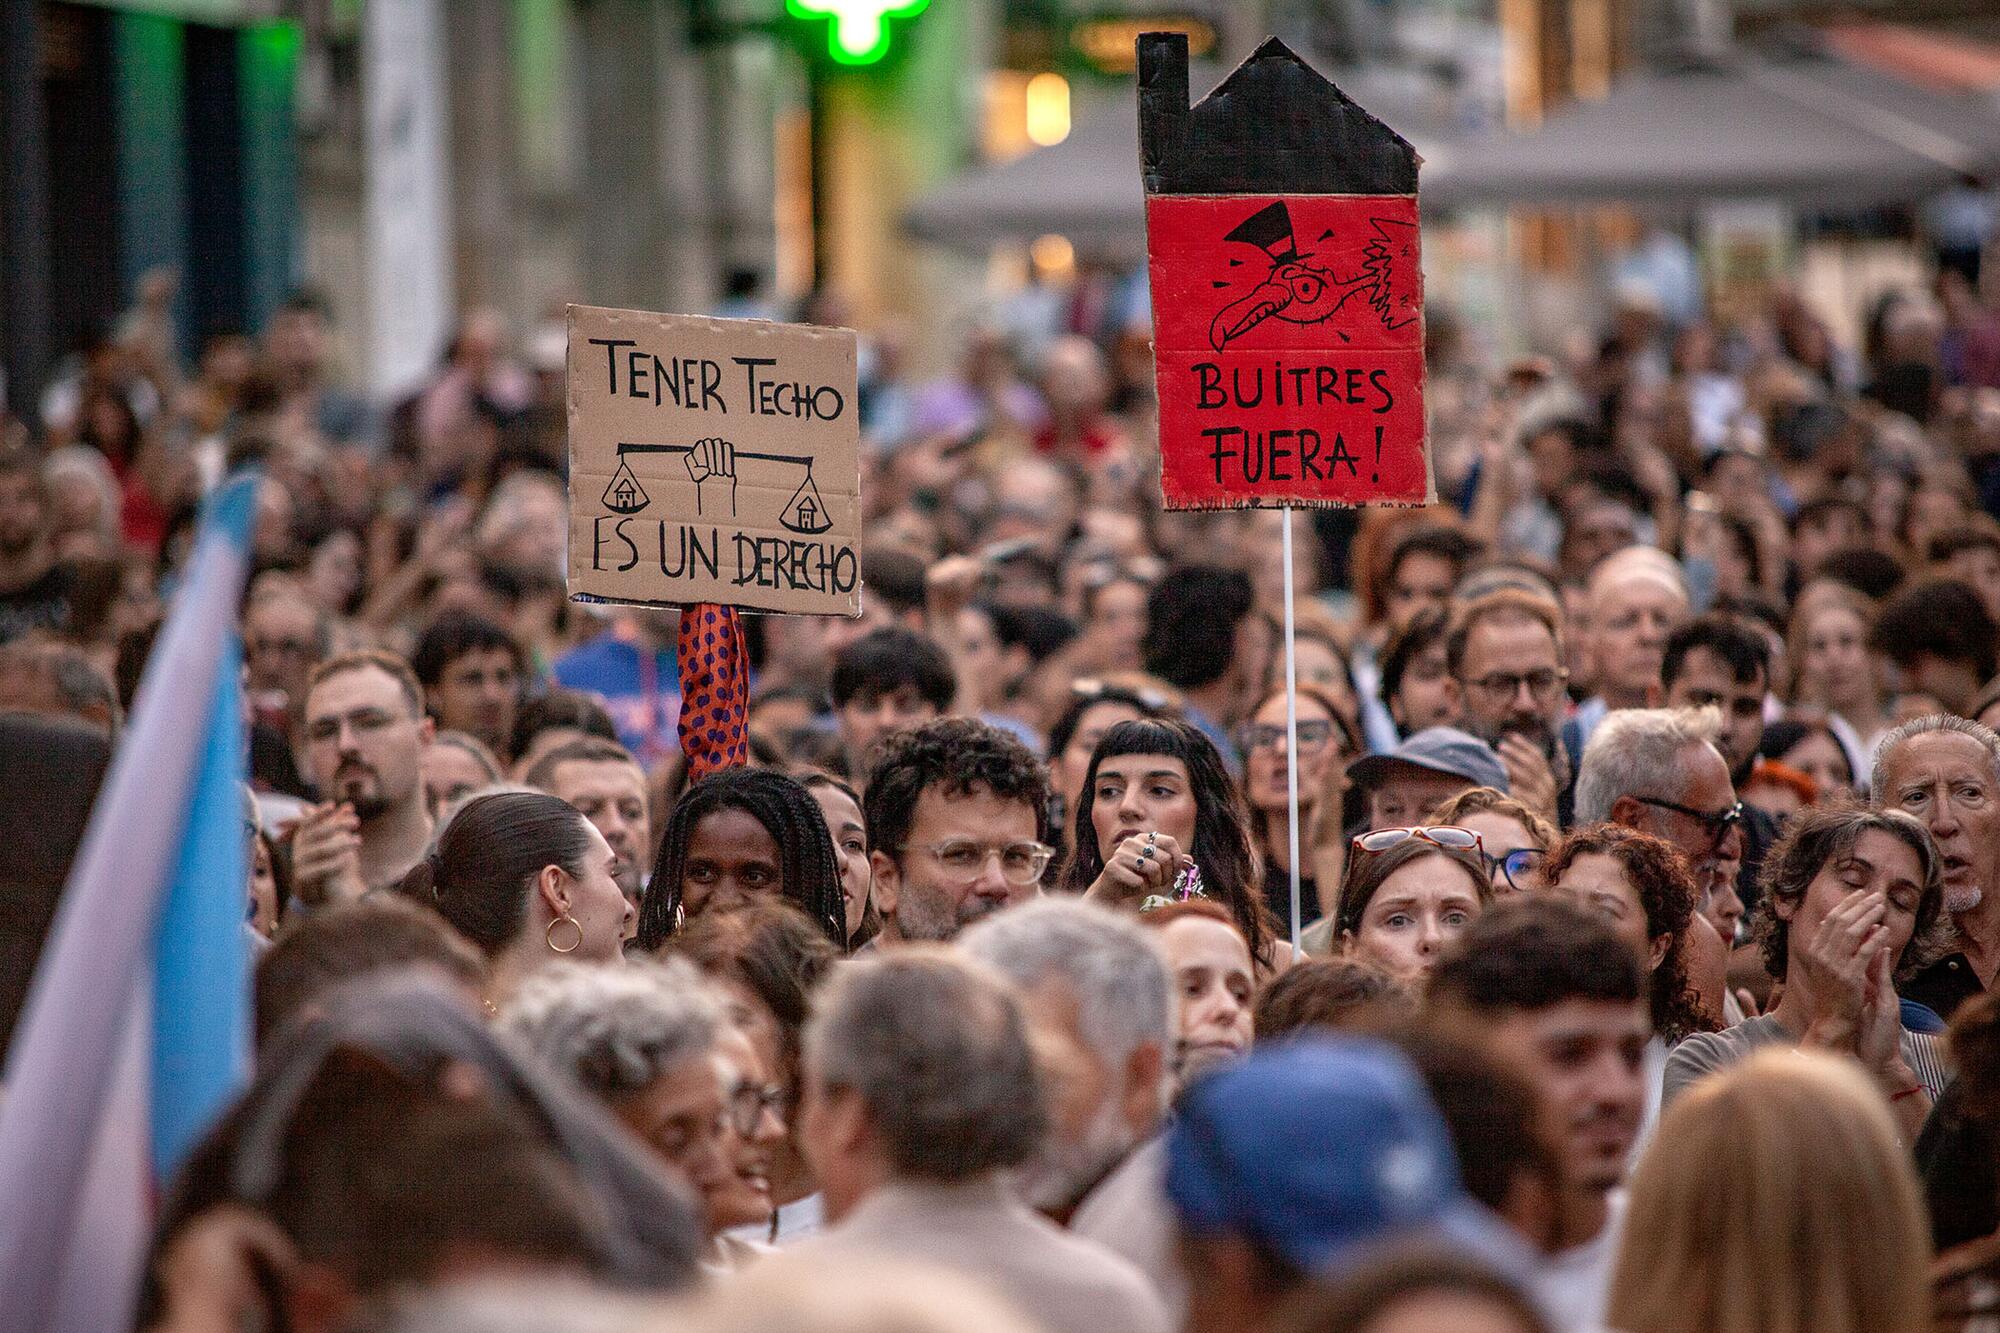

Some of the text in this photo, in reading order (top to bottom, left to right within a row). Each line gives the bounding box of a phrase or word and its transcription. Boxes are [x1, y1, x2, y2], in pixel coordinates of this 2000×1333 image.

[588, 339, 844, 421] TENER TECHO
[593, 515, 857, 595] ES UN DERECHO
